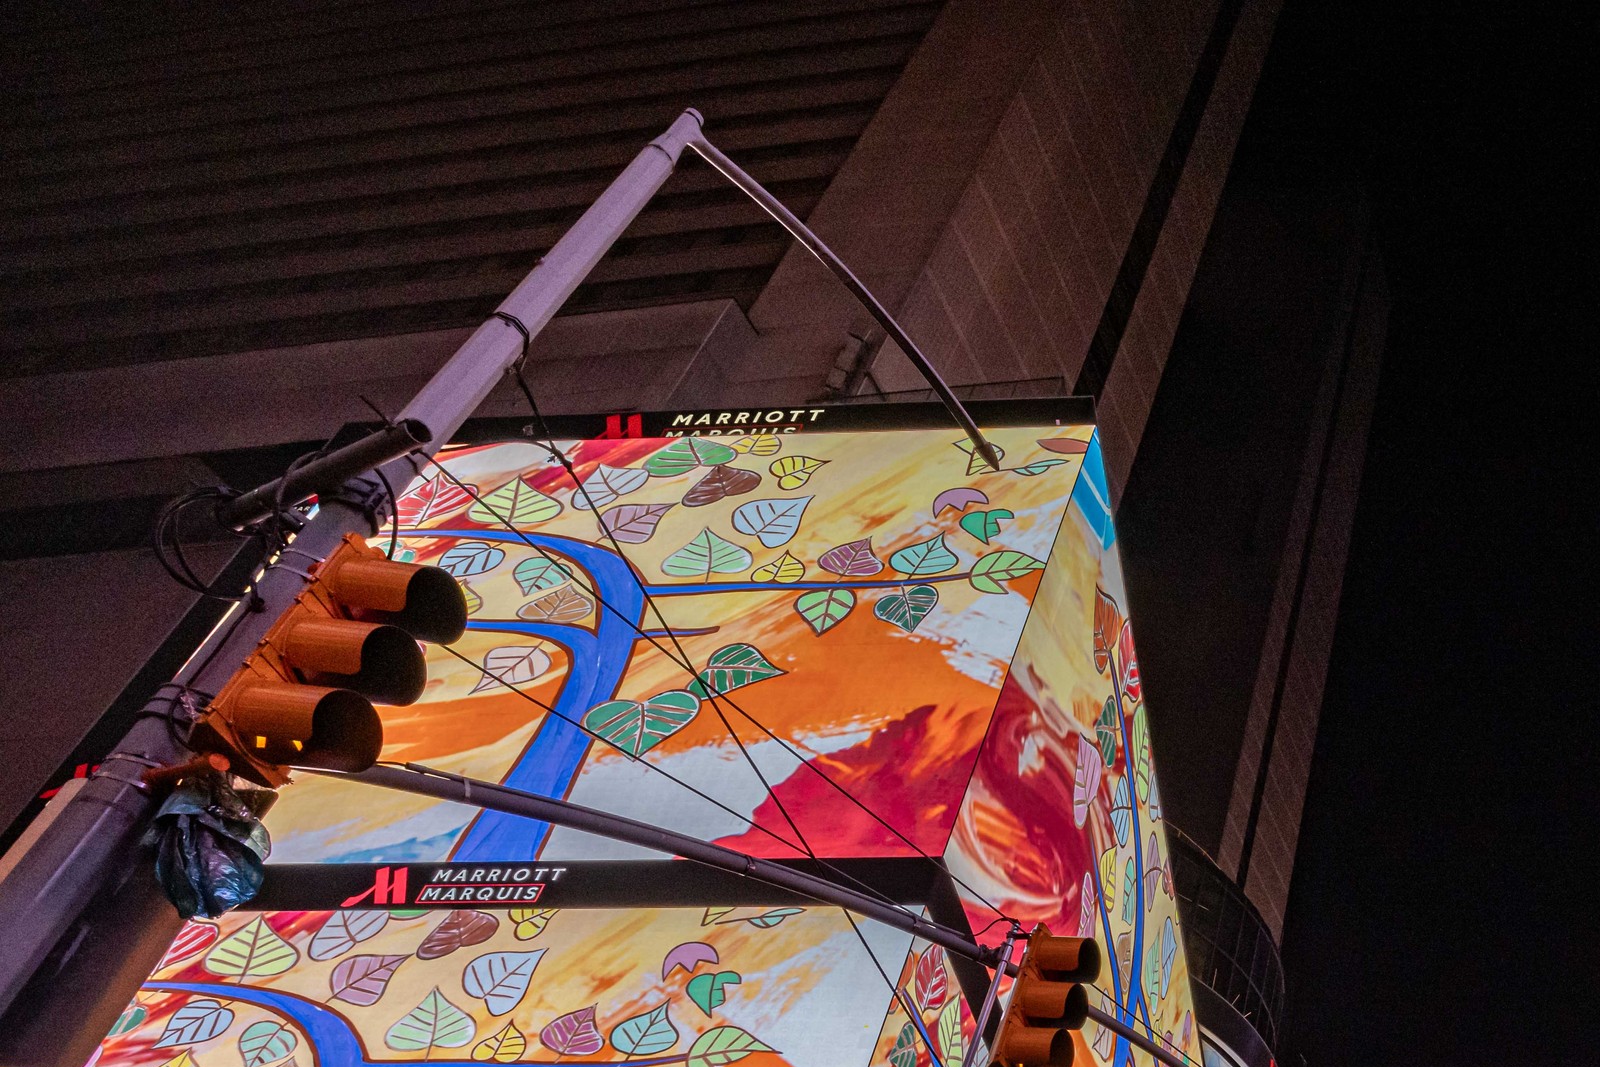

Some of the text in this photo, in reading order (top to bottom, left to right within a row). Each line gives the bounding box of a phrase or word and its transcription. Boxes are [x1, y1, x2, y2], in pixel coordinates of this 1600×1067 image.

[672, 409, 824, 426] MARRIOTT
[432, 868, 567, 882] MARRIOTT
[420, 887, 540, 901] MARQUIS
